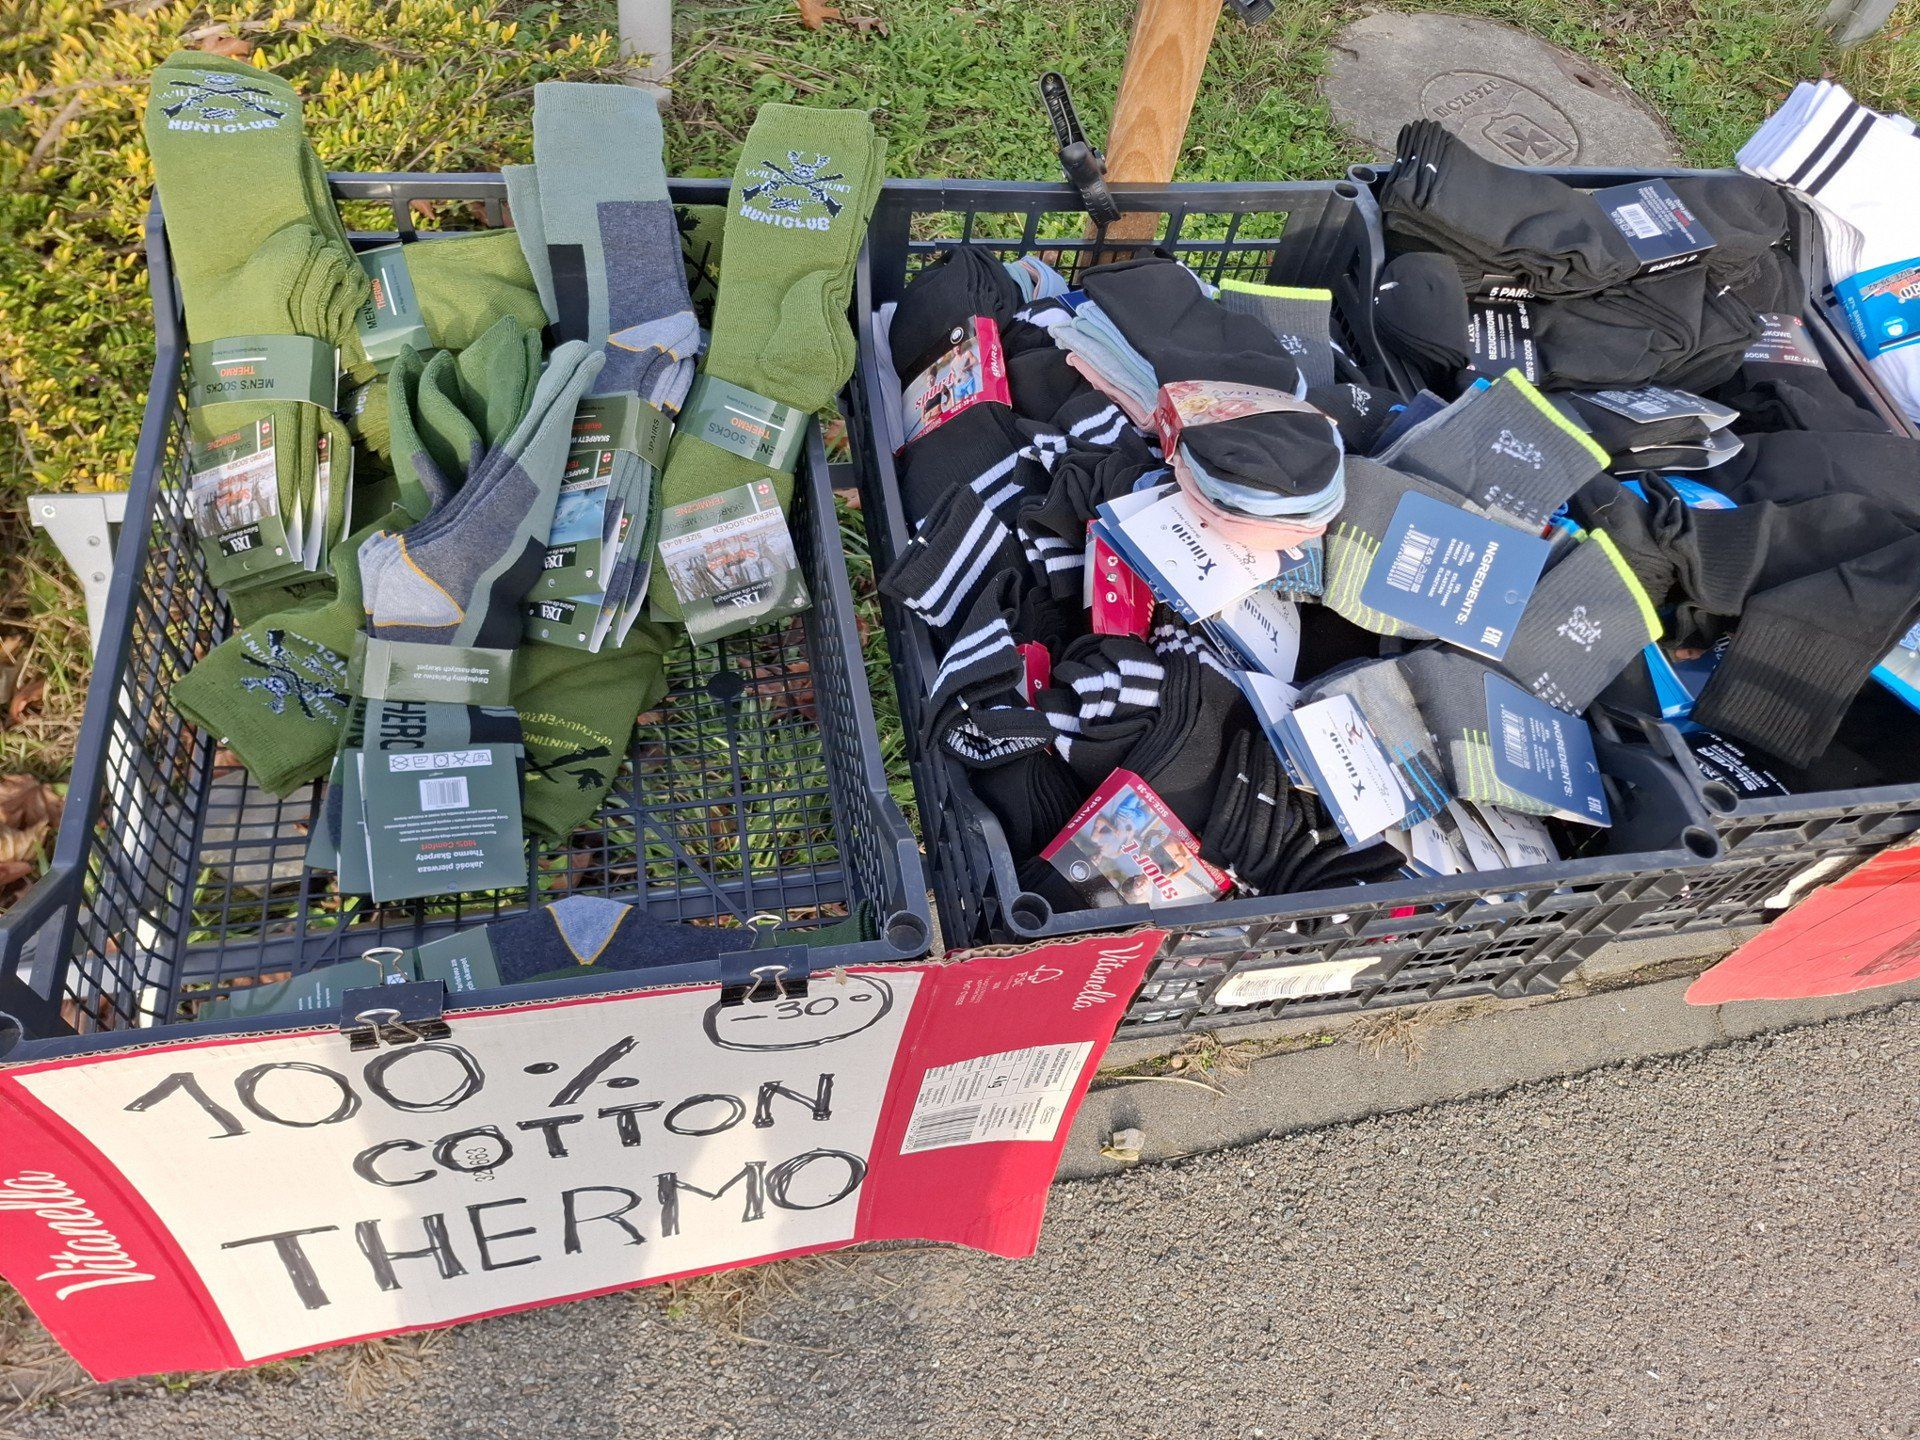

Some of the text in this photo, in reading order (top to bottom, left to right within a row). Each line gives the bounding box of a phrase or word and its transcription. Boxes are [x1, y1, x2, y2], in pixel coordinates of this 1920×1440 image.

[372, 278, 386, 310] THERMO
[1489, 287, 1536, 298] 5 PAIRS
[1485, 309, 1498, 360] BEZUCISKOWE
[206, 378, 275, 395] MEN'S SOCKS
[220, 365, 256, 378] THERMO
[578, 434, 611, 444] SKARPETY
[708, 421, 748, 446] SOCKS
[730, 417, 772, 441] THERMO
[1454, 540, 1499, 626] INGREDIENTS:
[1551, 719, 1574, 798] INGREDIENTS:
[1697, 746, 1758, 792] SILVER
[415, 849, 485, 862] Thermo Skarpety
[420, 841, 454, 851] Comfort
[417, 860, 485, 875] Jakość pierwsza
[1120, 838, 1180, 903] sport
[1071, 940, 1145, 1012] Vitanella
[352, 1072, 834, 1187] COTTON
[0, 1169, 157, 1301] Vitanella
[219, 1146, 869, 1311] THERMO
